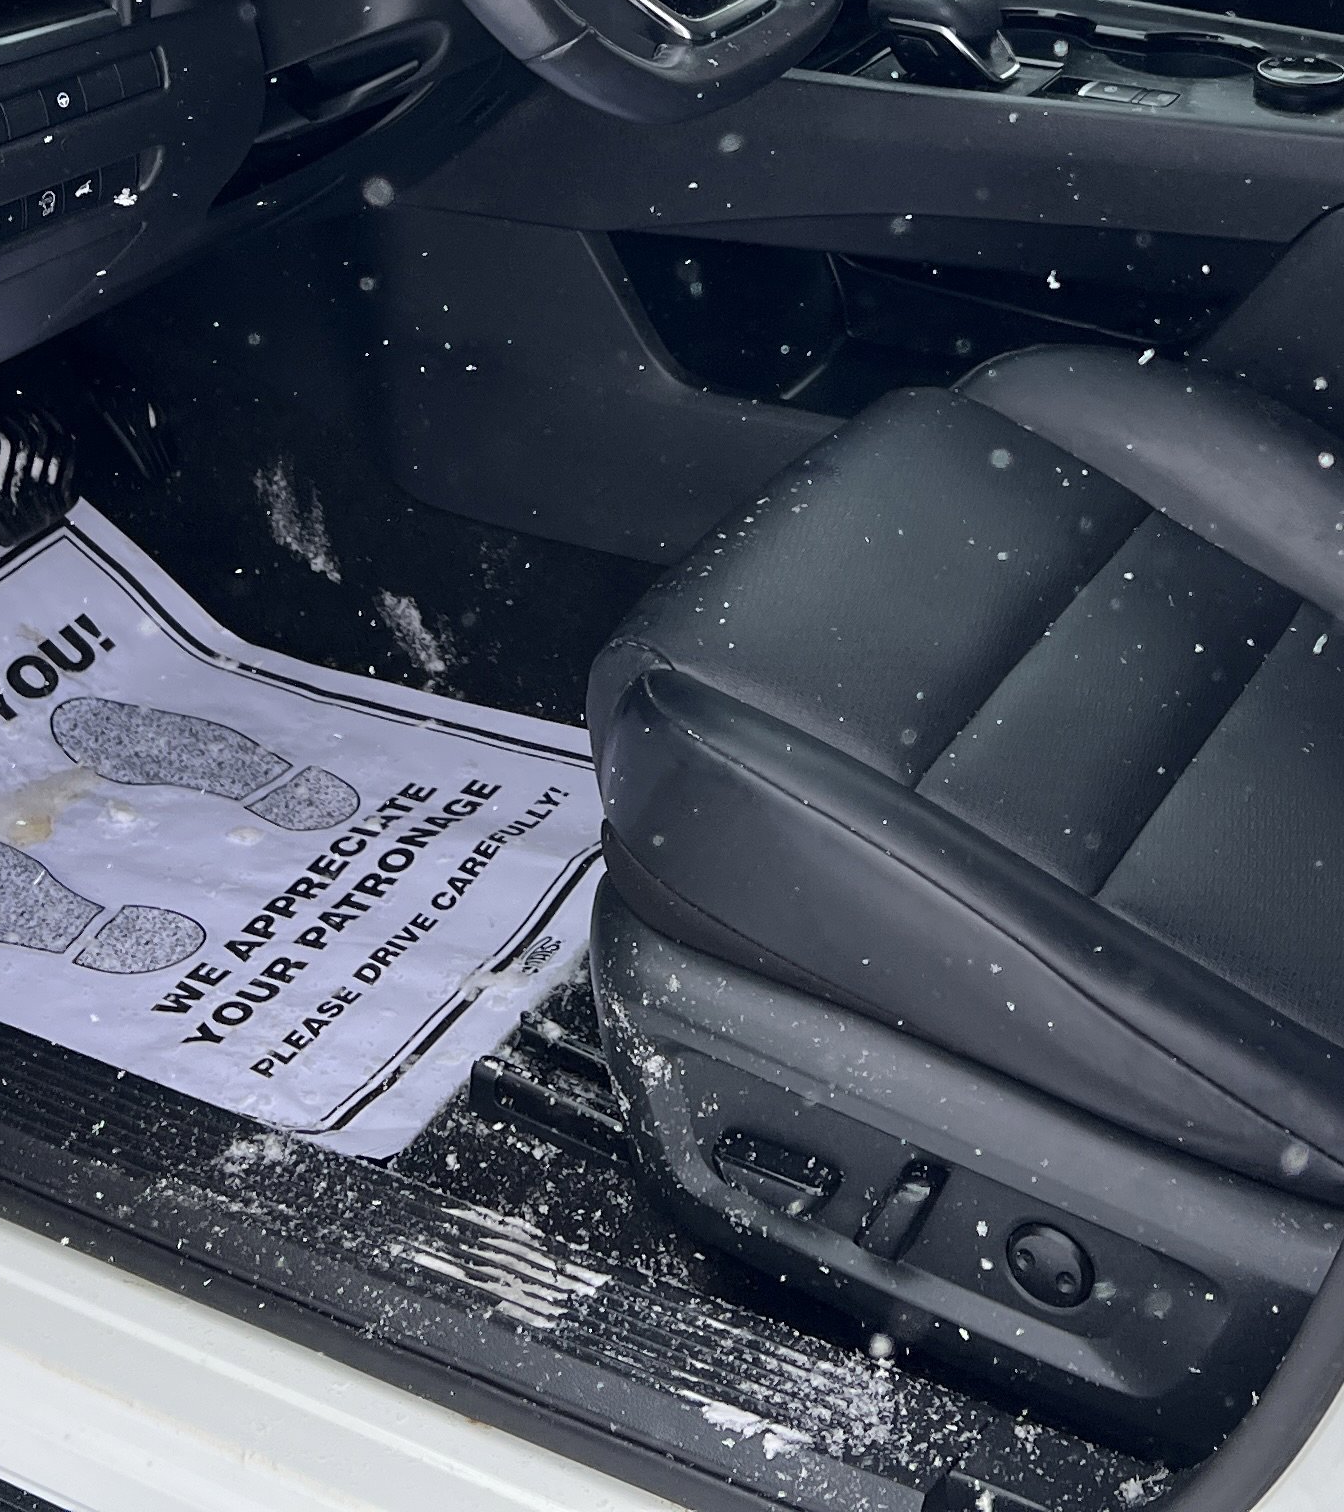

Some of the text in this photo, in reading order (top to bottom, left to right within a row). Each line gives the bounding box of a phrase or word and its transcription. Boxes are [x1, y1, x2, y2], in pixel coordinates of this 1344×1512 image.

[151, 782, 438, 1015] WE APPRECIATE
[181, 778, 503, 1045] YOUR PATRONAGE
[249, 985, 363, 1078] PLEASE
[353, 911, 440, 986] DRIVE
[431, 785, 570, 911] CAREFULLY!
